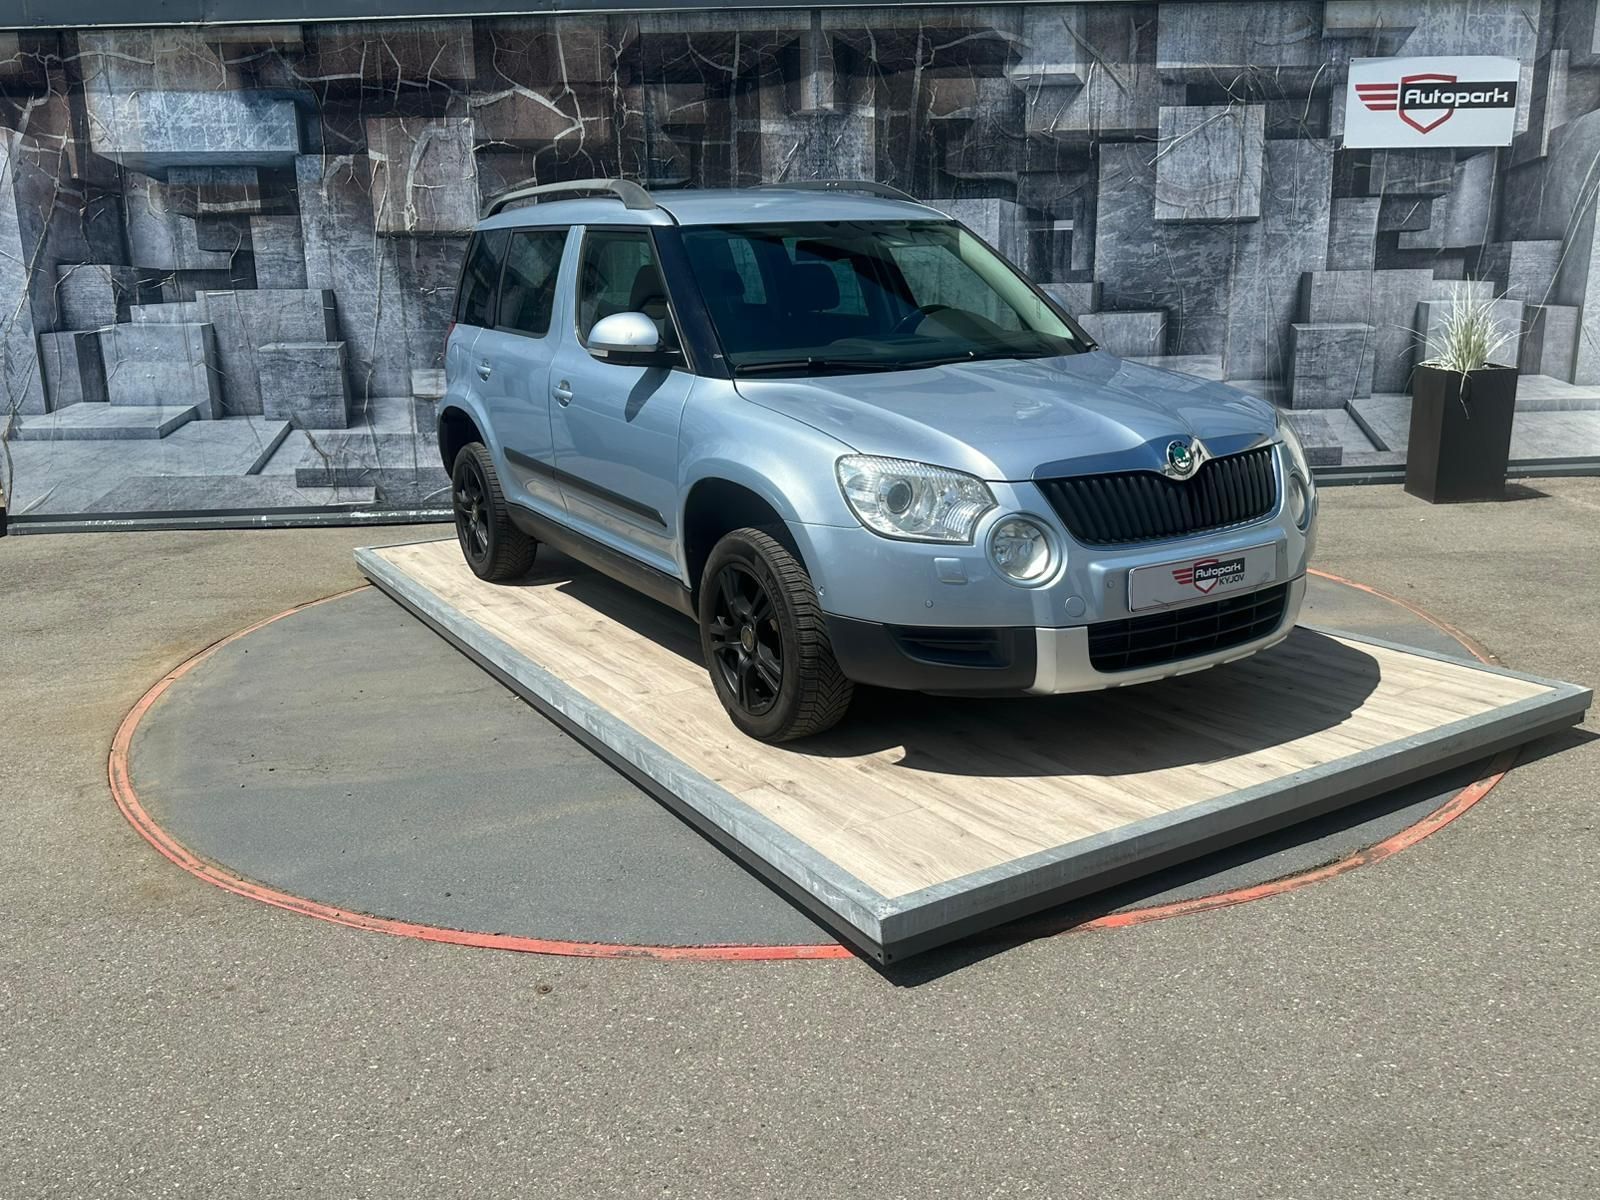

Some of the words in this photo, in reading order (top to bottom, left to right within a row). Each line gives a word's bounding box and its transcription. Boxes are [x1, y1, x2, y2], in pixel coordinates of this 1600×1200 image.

[1404, 87, 1509, 107] Autopark
[1195, 562, 1242, 579] Autopark
[1218, 574, 1245, 586] KYJOV
